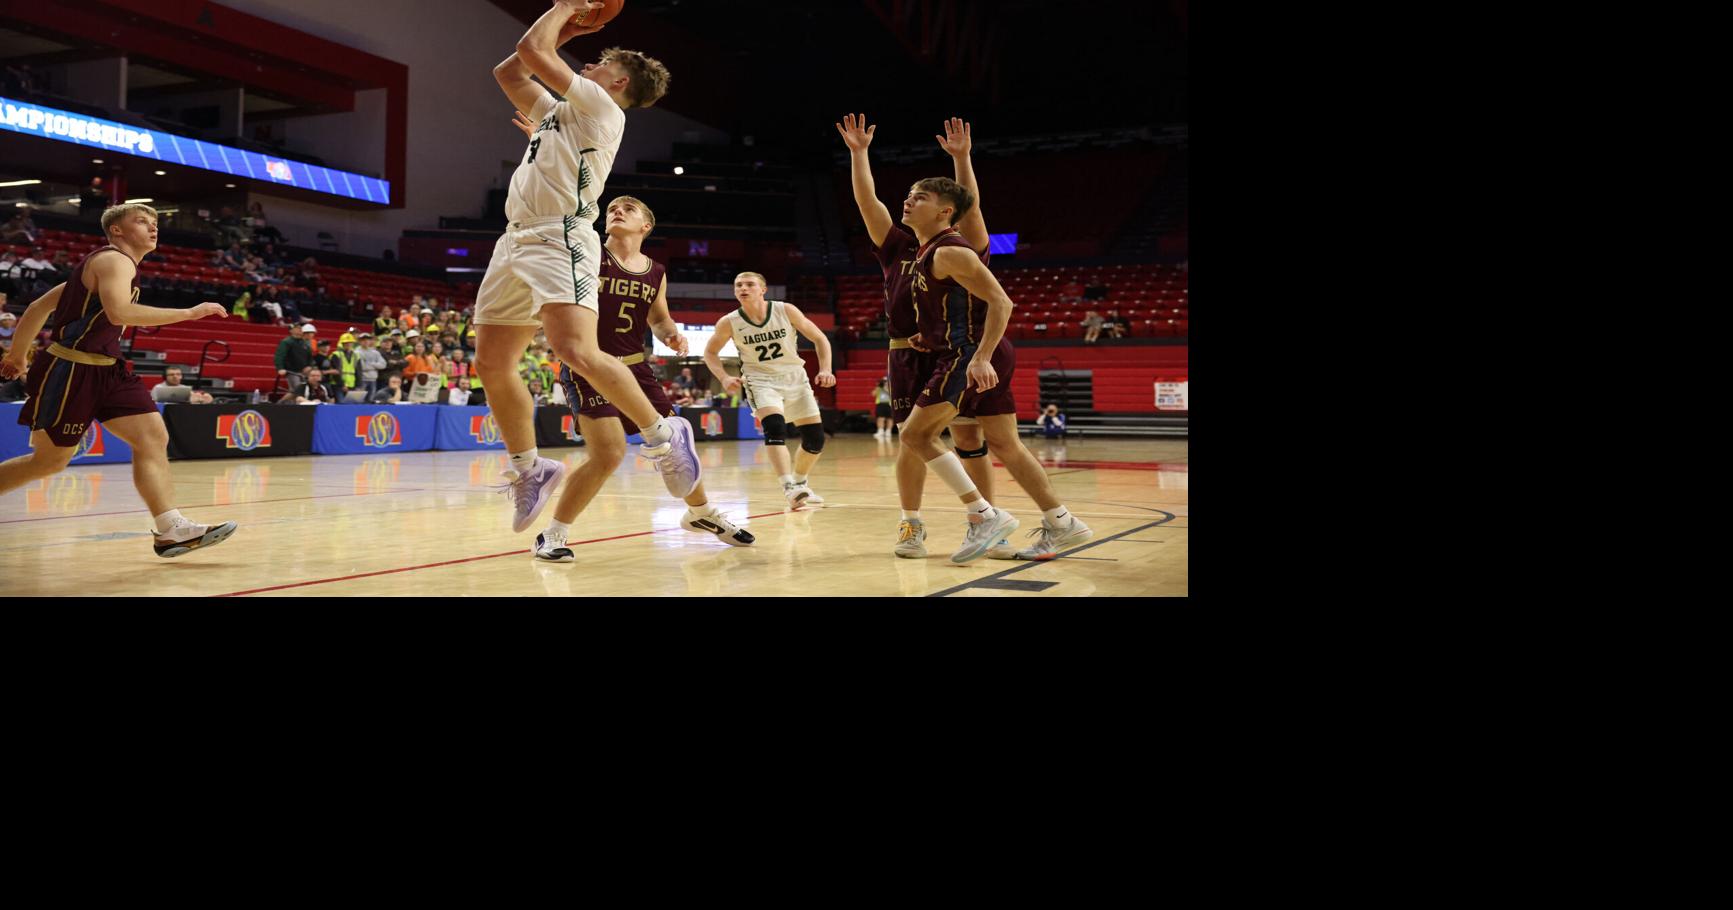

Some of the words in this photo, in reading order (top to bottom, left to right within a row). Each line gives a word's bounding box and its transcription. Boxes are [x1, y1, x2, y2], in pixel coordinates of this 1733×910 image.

[598, 276, 657, 304] TIGERS
[615, 302, 636, 333] 5
[743, 328, 787, 345] JAGUARS
[755, 342, 784, 362] 22
[63, 423, 84, 435] DCS
